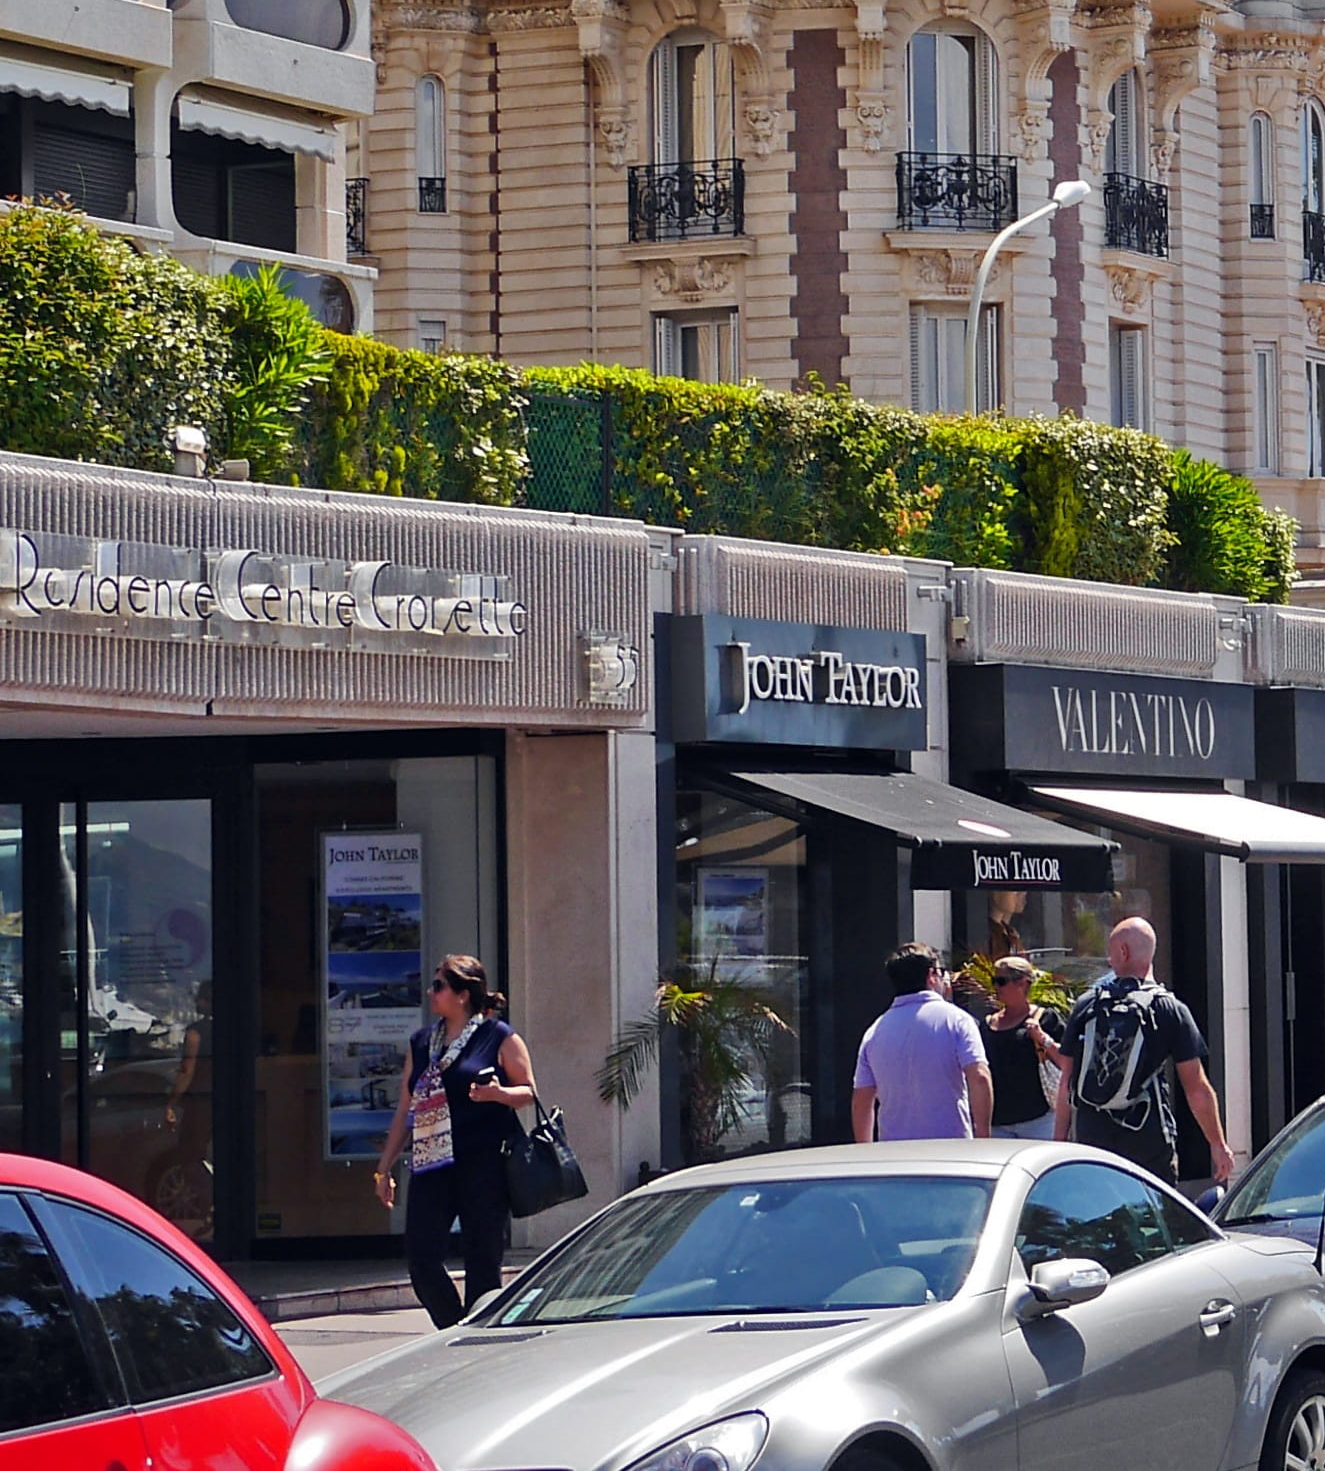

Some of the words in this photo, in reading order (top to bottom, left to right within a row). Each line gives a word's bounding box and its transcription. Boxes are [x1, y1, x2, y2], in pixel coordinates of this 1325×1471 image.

[16, 531, 215, 620] Residence
[236, 551, 356, 628] Centre
[371, 561, 528, 636] Croisette
[734, 641, 815, 715] JOHN
[820, 650, 922, 709] TAYLOR
[1051, 686, 1215, 760] VALENTINO
[329, 847, 365, 866] JOHN
[367, 846, 418, 862] TAYLOR
[972, 849, 1009, 887] JOHN
[1010, 850, 1061, 881] TAYLOR
